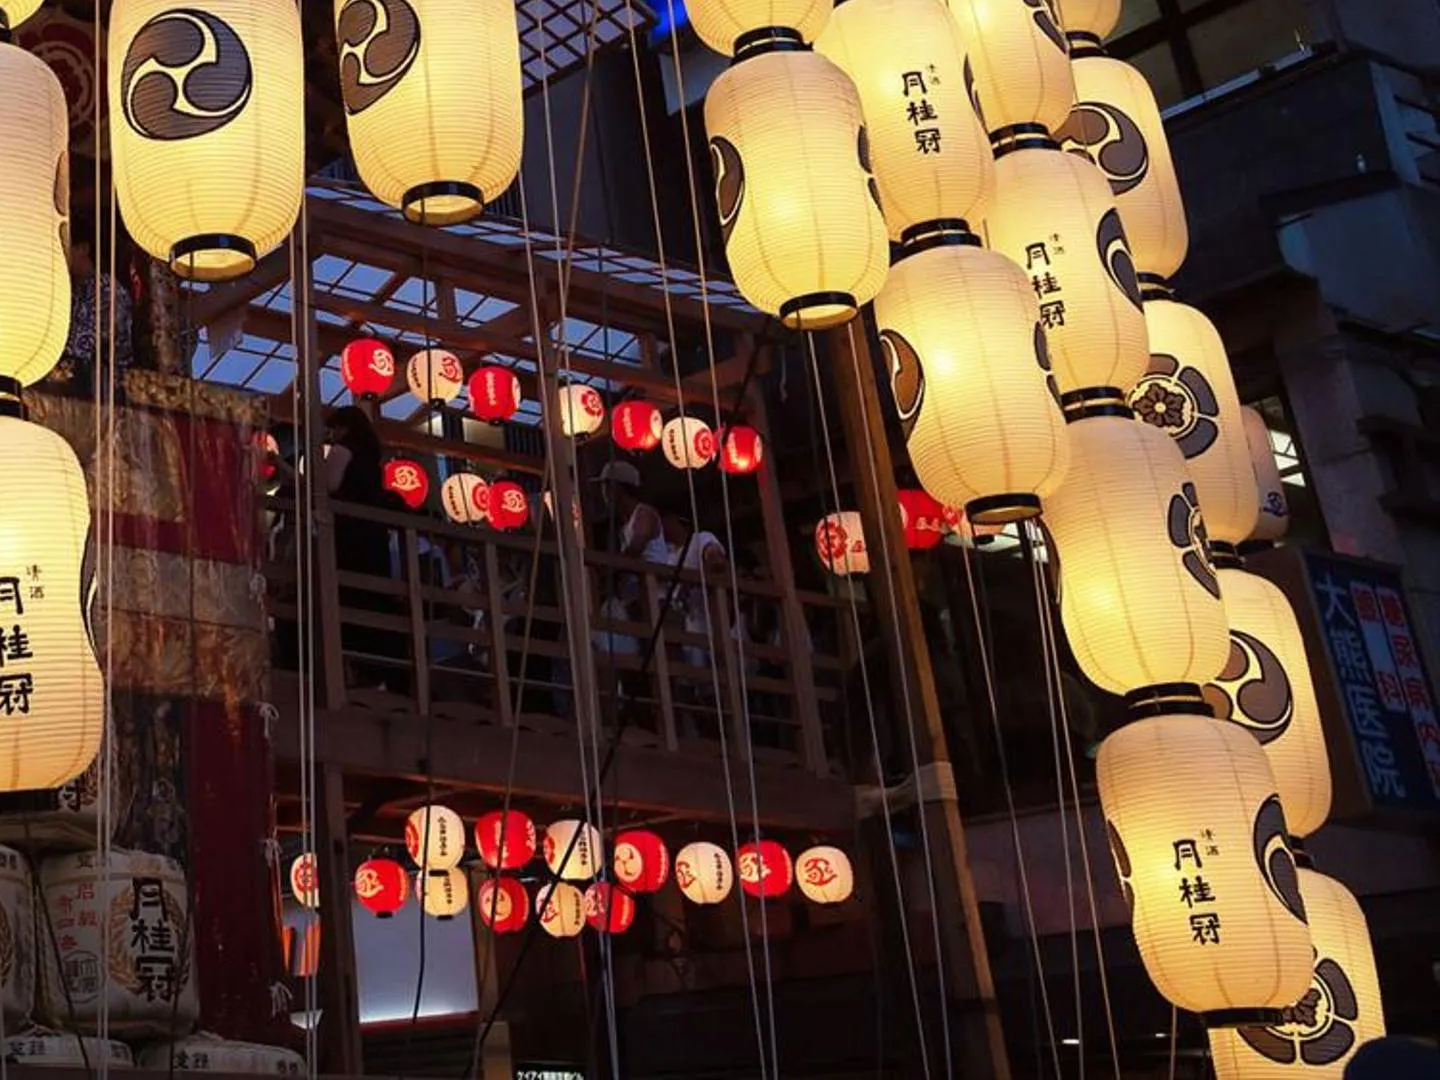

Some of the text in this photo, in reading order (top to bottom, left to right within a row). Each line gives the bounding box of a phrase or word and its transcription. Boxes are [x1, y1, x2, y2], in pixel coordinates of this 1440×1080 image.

[902, 71, 941, 154] 月桂冠
[1025, 242, 1065, 329] 月桂冠
[129, 877, 176, 1003] 月桂冠
[1173, 839, 1221, 945] 月桂冠
